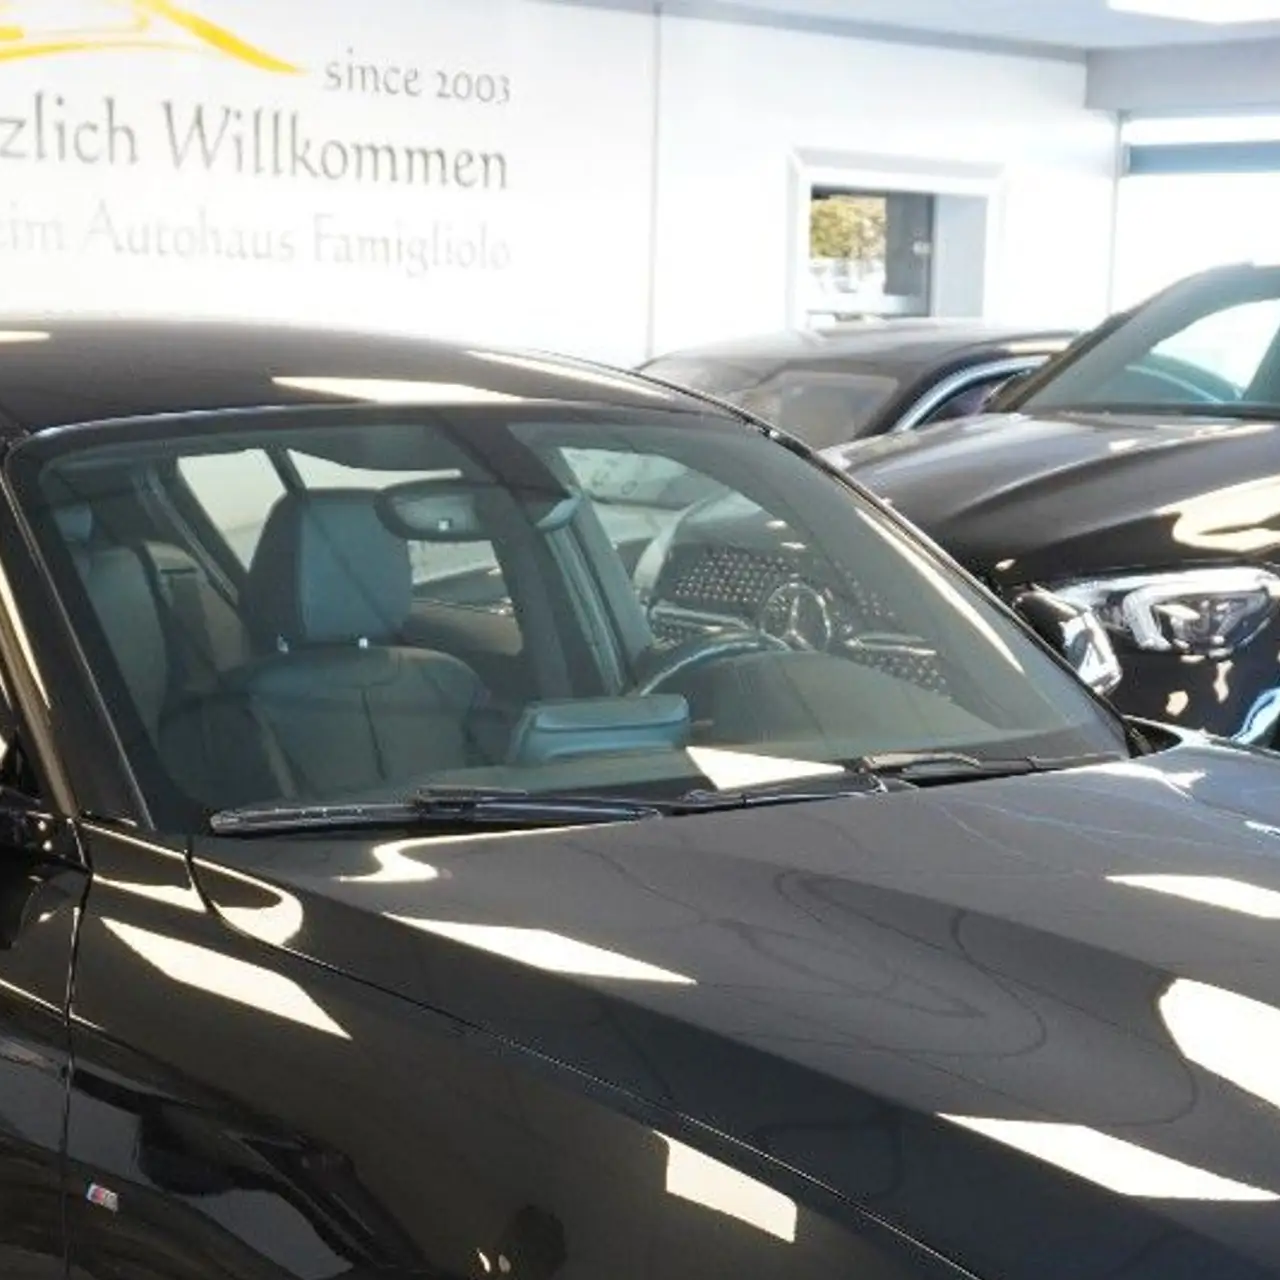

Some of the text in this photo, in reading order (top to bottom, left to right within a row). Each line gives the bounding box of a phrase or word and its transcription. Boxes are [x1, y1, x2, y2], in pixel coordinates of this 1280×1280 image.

[324, 47, 510, 104] since 2003
[161, 99, 509, 190] Willkommen
[81, 198, 296, 263] Autohaus
[311, 212, 512, 279] Famigliolo
